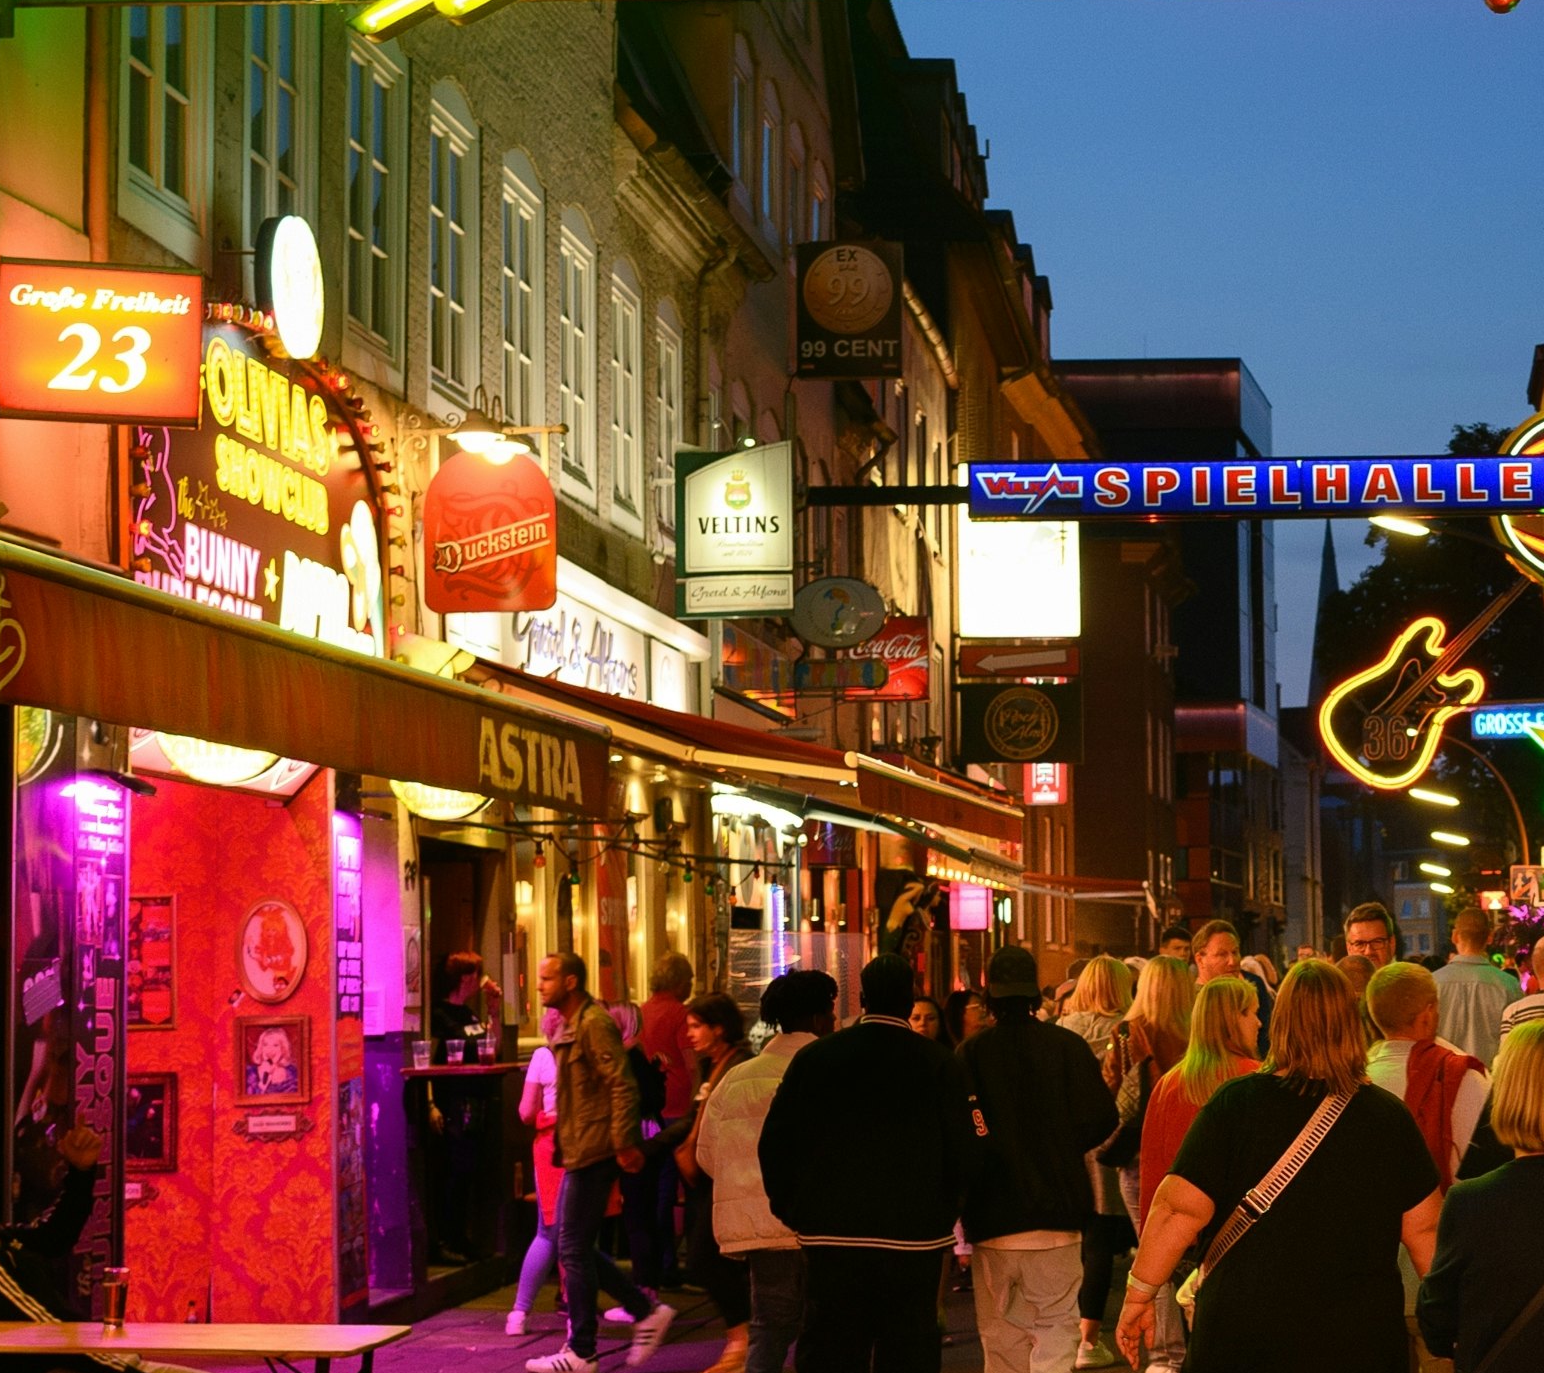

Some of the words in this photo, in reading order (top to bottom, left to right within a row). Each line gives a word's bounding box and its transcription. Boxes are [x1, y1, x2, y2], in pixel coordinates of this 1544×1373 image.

[836, 249, 858, 262] EX
[9, 284, 87, 313] Große
[91, 288, 191, 316] Freiheit
[828, 275, 870, 308] 99
[47, 322, 152, 394] 23
[801, 340, 826, 358] 99
[834, 339, 899, 357] CENT
[215, 433, 330, 535] SHOWCLUB
[1094, 460, 1535, 507] SPIELHALLE
[698, 515, 780, 535] VELTINS
[184, 521, 261, 600] BUNNY
[434, 522, 548, 574] Duckstein
[730, 585, 742, 598] &
[1363, 715, 1409, 761] 36
[1475, 712, 1531, 735] GROSSE
[479, 715, 583, 806] ASTRA
